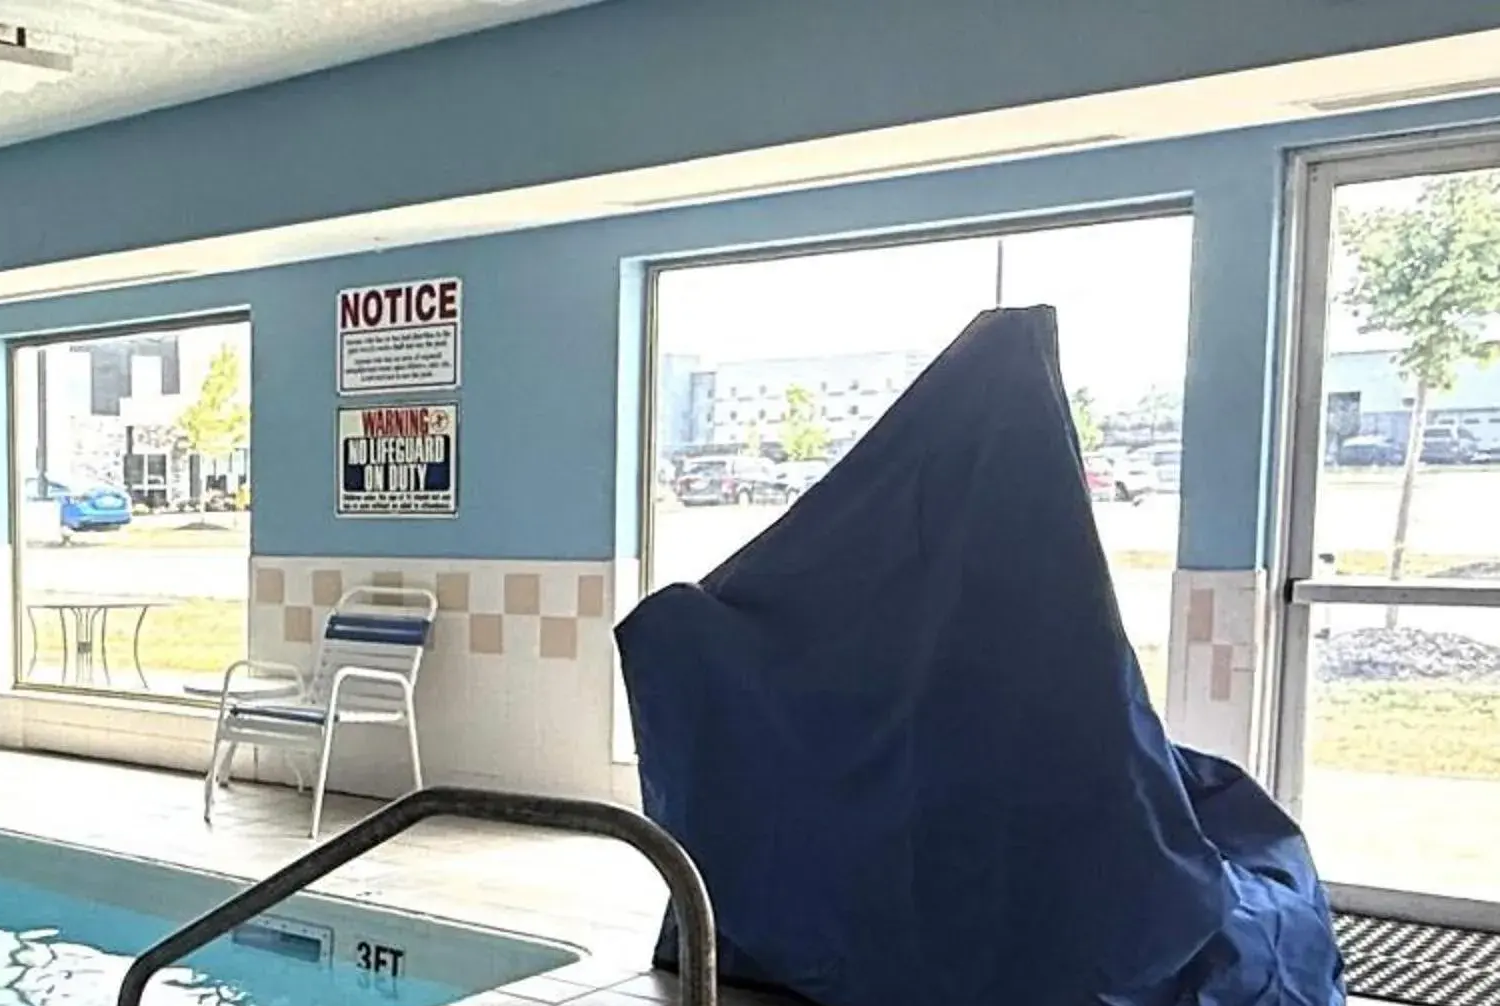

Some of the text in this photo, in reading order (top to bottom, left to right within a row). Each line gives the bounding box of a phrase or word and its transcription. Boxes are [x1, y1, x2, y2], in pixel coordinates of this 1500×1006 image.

[341, 281, 457, 328] NOTICE
[362, 408, 429, 437] WARNING
[348, 434, 445, 465] NO LIFEGUARD
[364, 462, 427, 491] ON DUTY
[356, 941, 405, 978] 3FT
